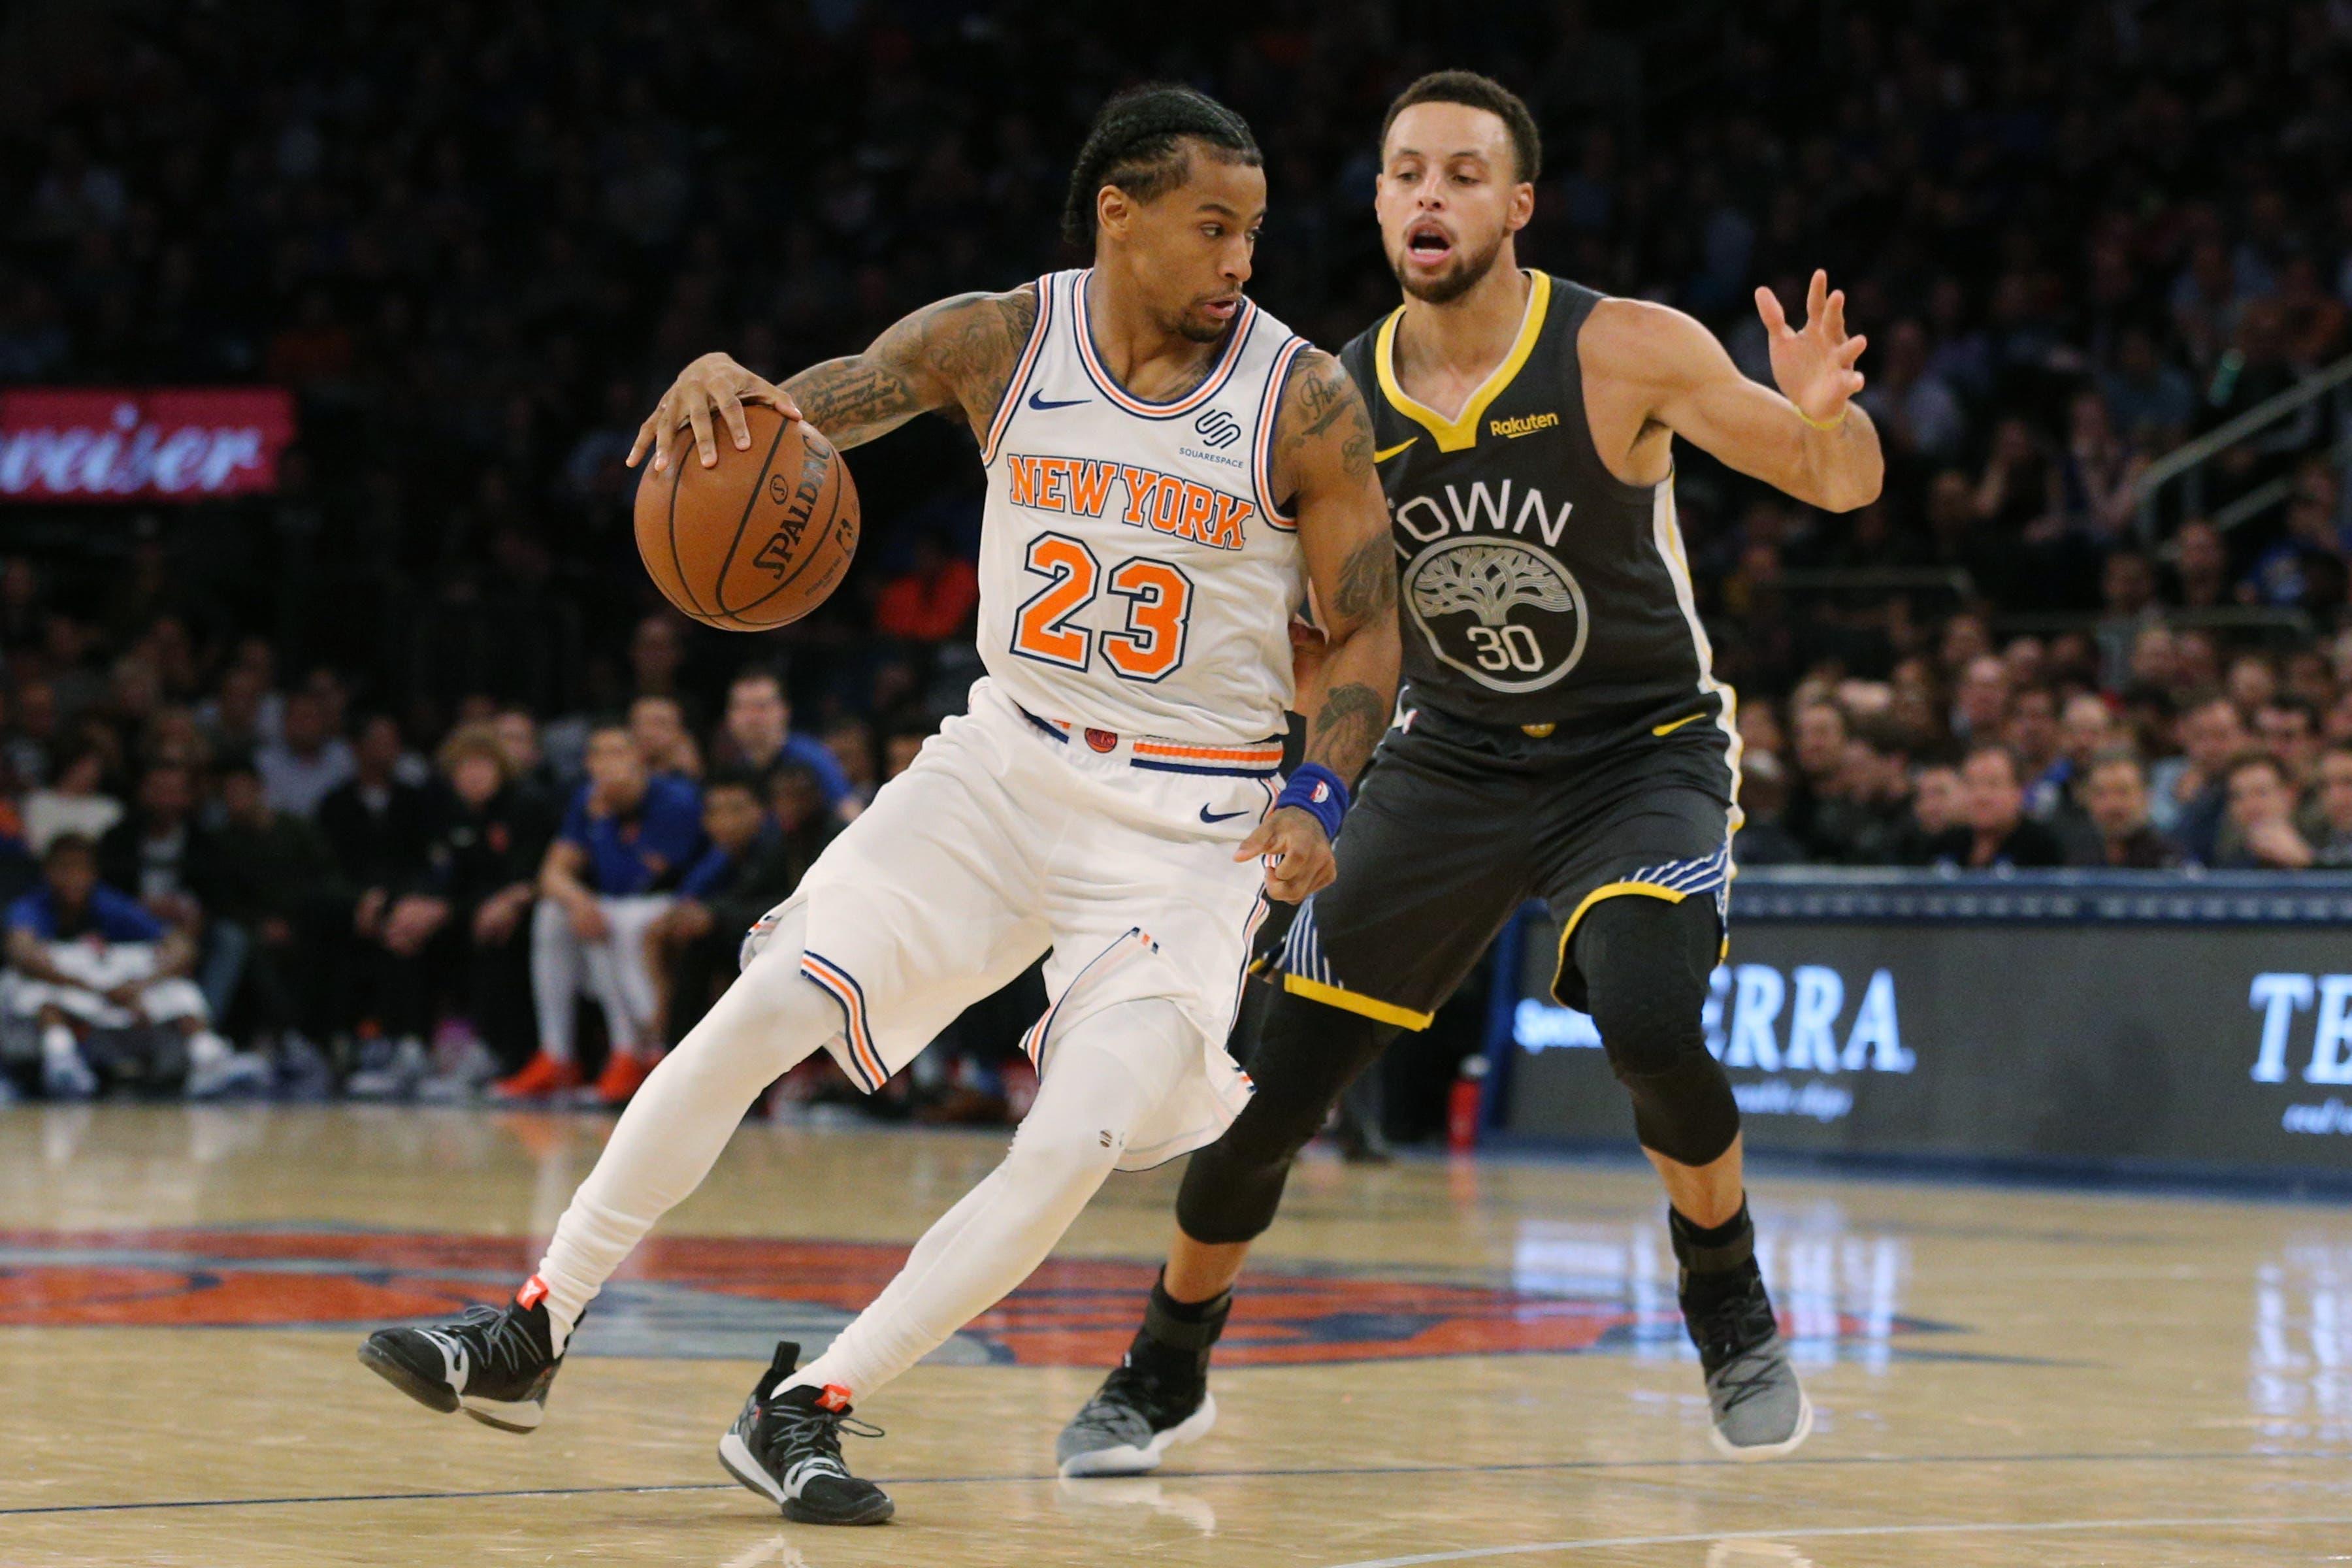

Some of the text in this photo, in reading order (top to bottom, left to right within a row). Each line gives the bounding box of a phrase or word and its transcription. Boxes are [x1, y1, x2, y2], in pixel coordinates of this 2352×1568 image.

[1179, 447, 1244, 469] SQUARESPACE
[1490, 412, 1559, 438] Rakuten
[753, 434, 831, 580] SPALDING
[1007, 453, 1256, 551] NEW YORK
[1387, 479, 1573, 560] OWN
[1009, 531, 1194, 684] 23
[1466, 625, 1544, 672] 30
